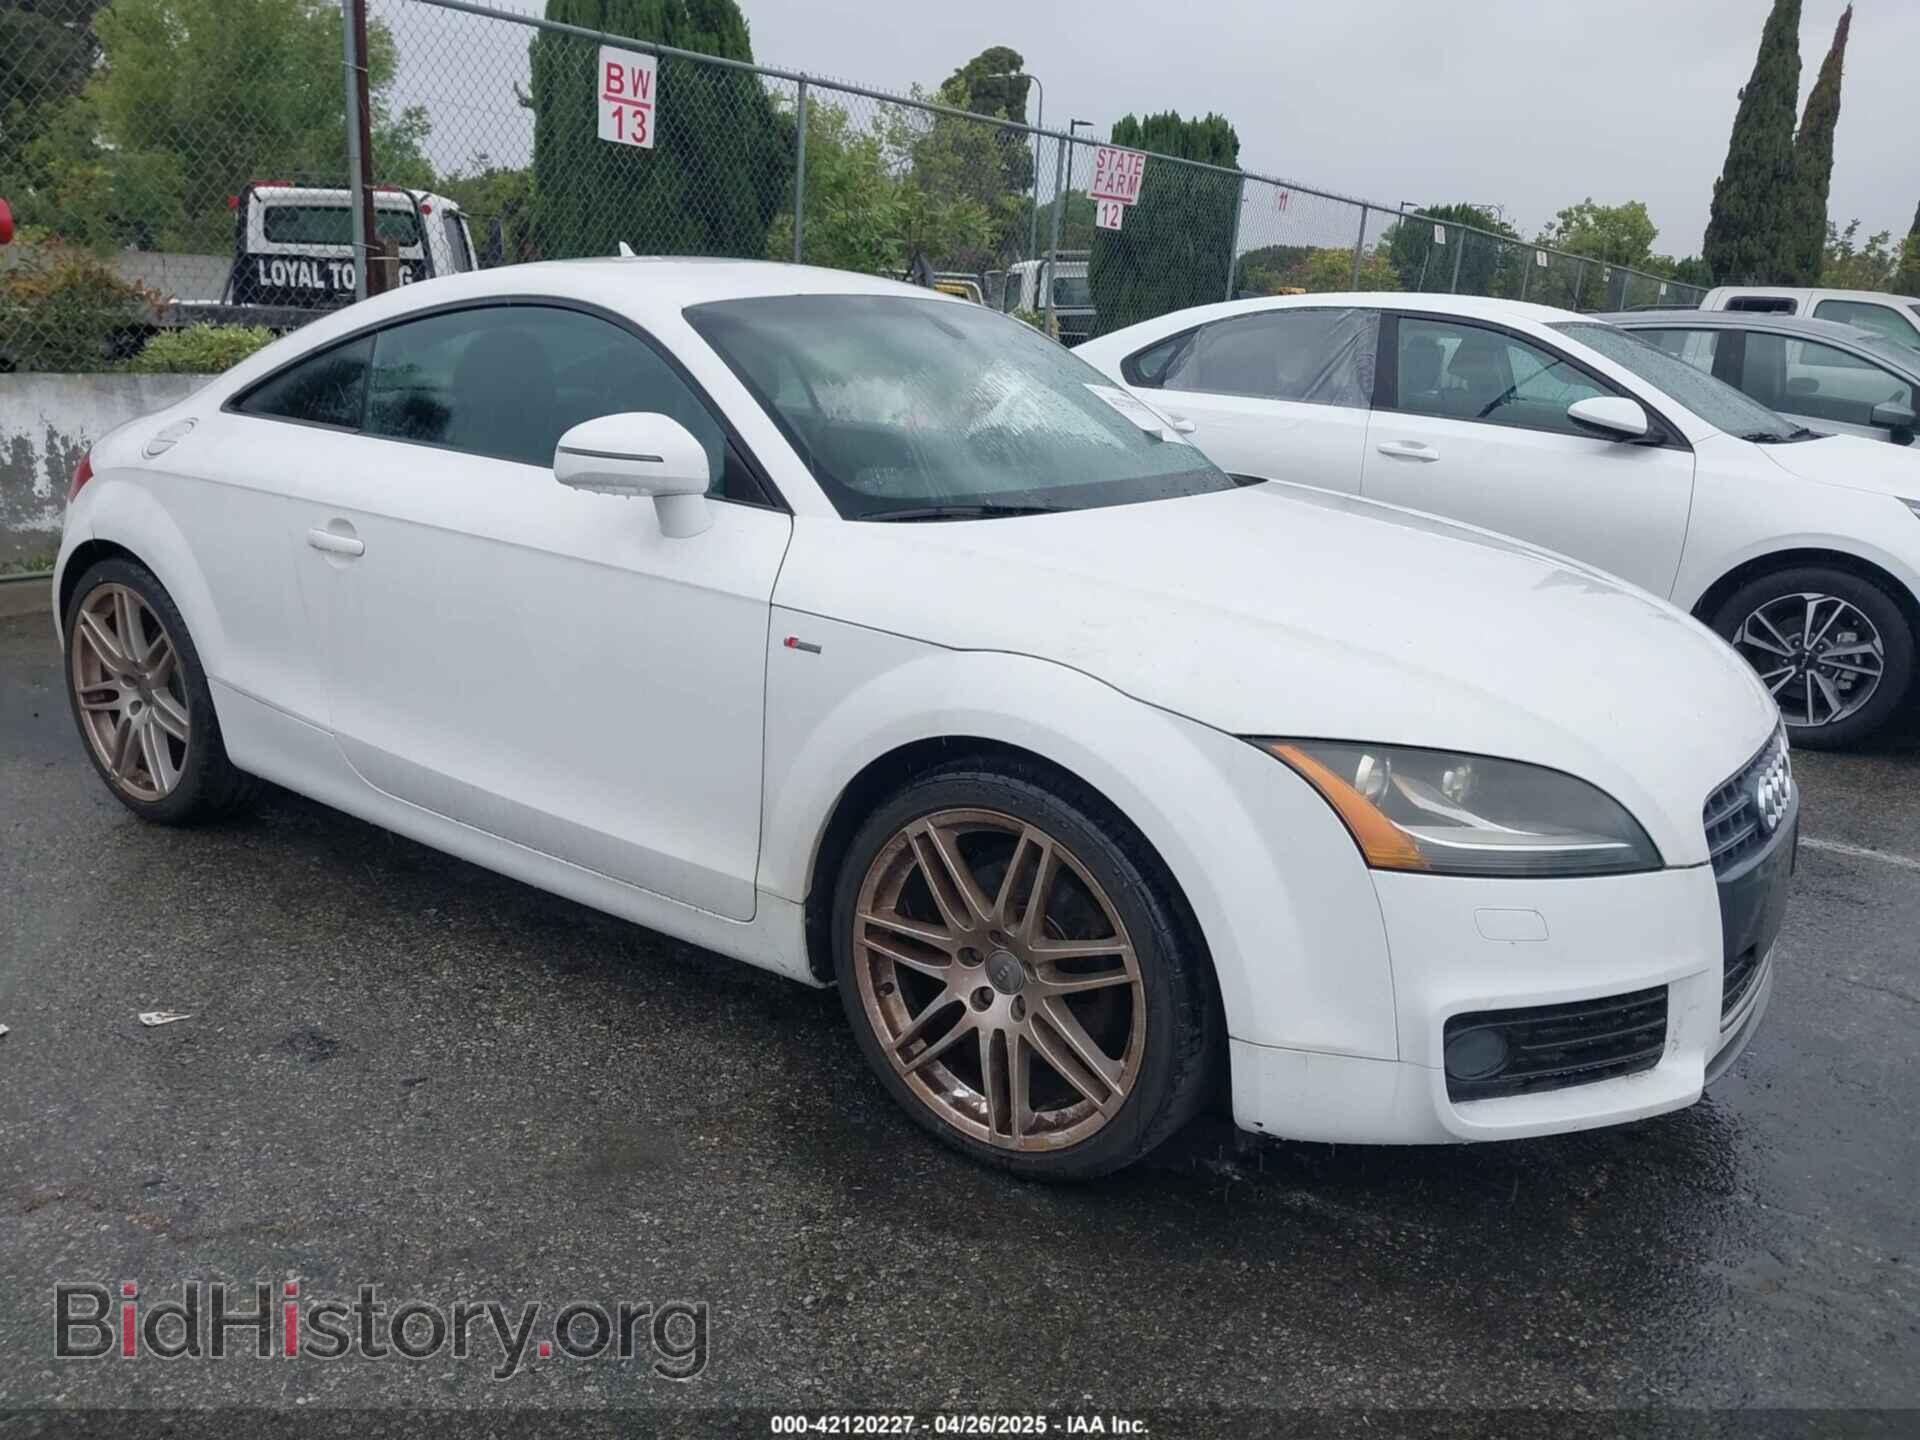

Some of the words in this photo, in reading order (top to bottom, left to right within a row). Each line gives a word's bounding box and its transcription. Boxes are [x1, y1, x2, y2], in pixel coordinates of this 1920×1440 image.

[606, 62, 651, 99] BW
[612, 105, 647, 143] 13
[1097, 148, 1144, 175] STATE
[1094, 170, 1138, 195] FARM
[1102, 203, 1119, 227] 12
[258, 259, 325, 289] LOYAL
[328, 263, 413, 290] TOG
